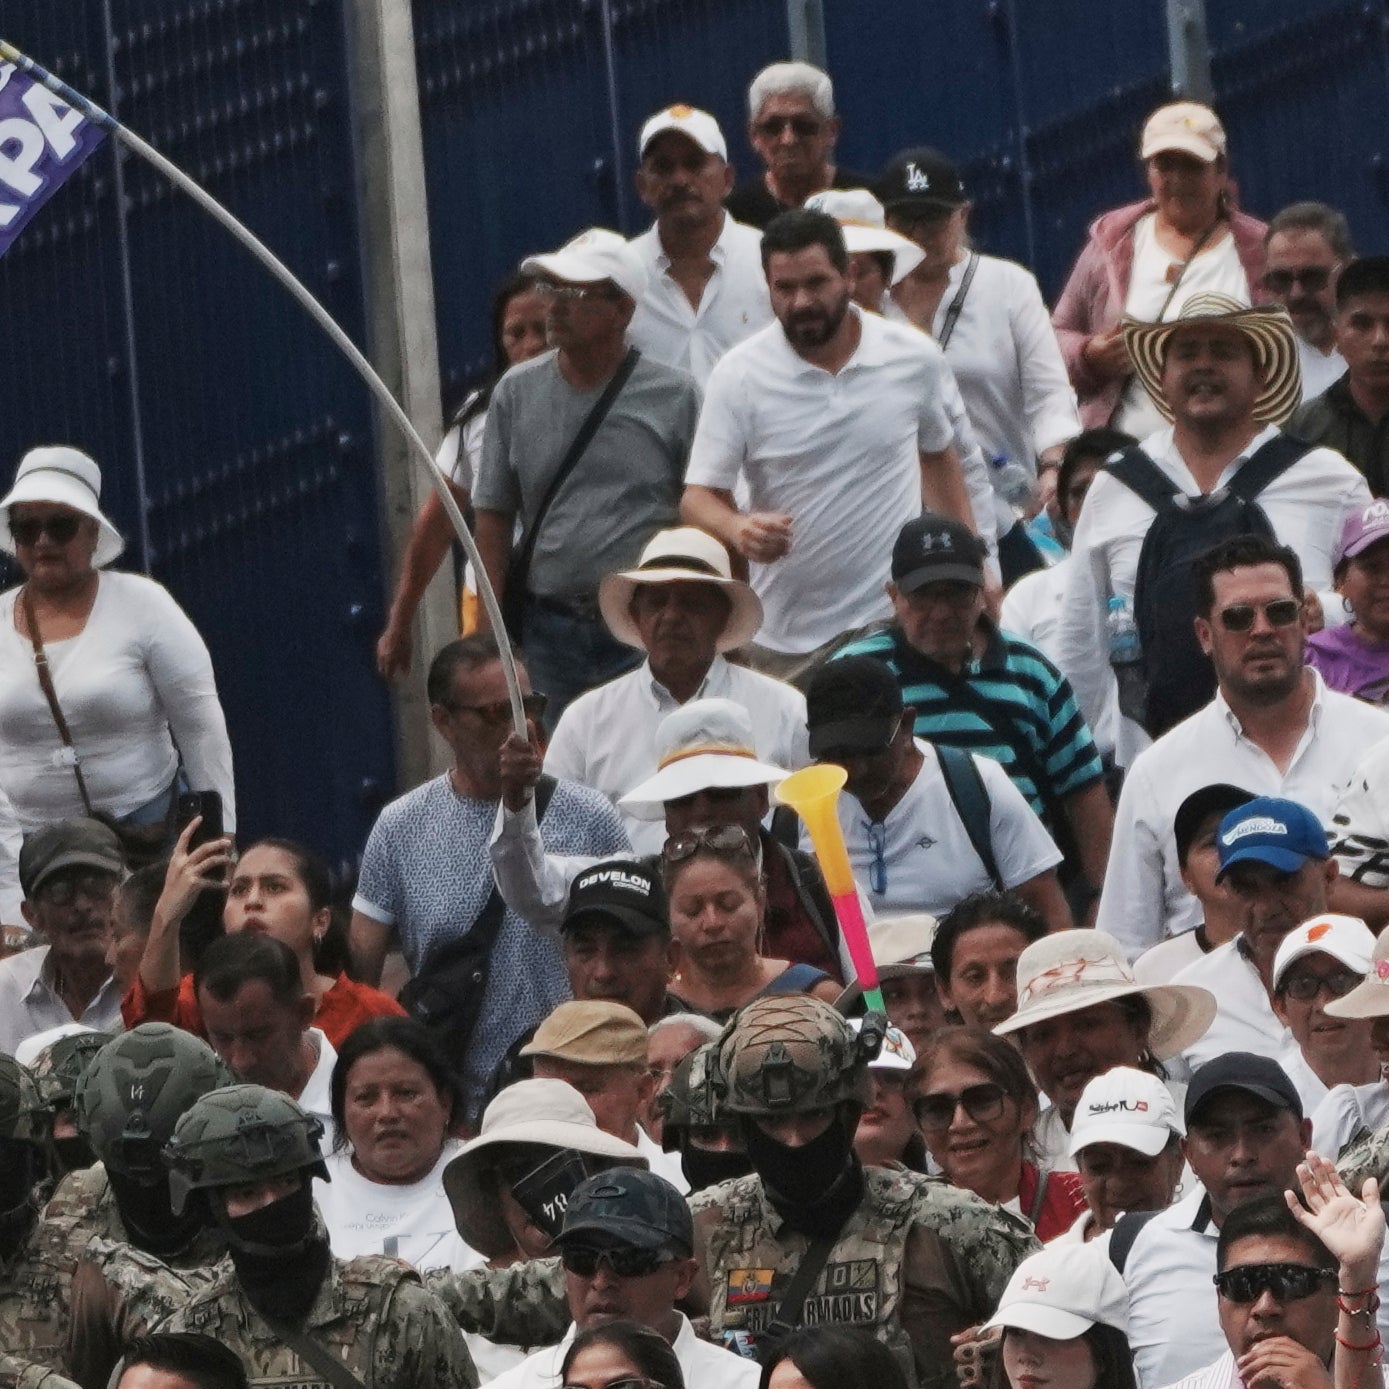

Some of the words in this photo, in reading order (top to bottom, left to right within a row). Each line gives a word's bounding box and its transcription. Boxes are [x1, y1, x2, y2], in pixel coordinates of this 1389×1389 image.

[0, 83, 85, 225] PA
[906, 162, 929, 191] LA
[1237, 822, 1285, 836] MENDOZA
[579, 870, 652, 891] DEVELON
[804, 1292, 876, 1326] RMADAS
